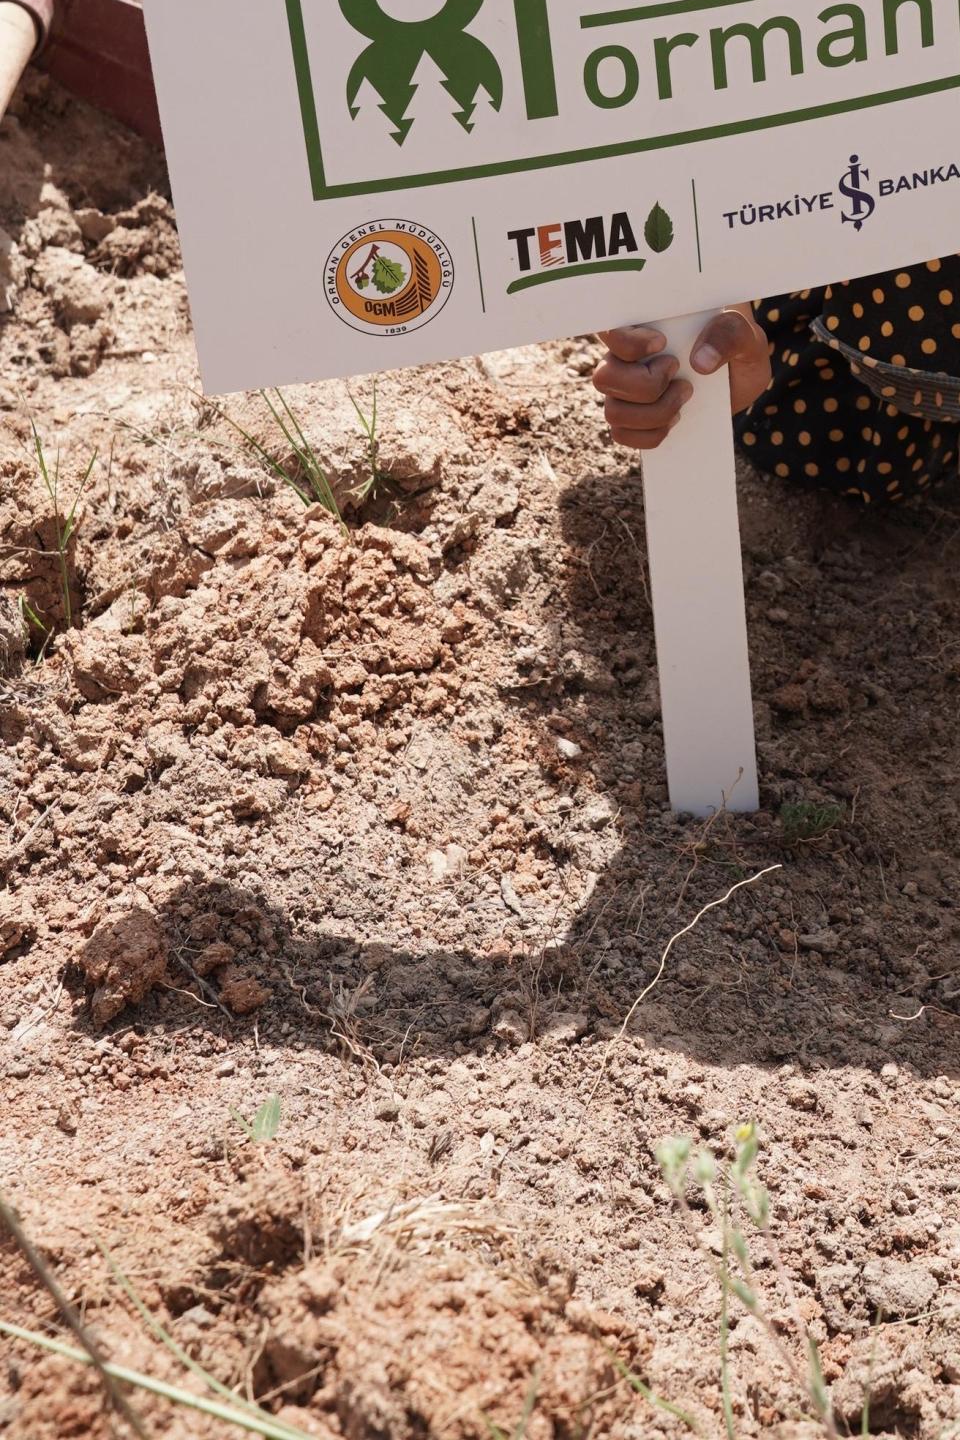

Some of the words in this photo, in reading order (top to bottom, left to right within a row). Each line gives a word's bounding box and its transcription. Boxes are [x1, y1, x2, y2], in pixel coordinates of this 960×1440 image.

[723, 192, 834, 229] TÜRKİYE
[507, 211, 639, 271] TEMA
[328, 255, 340, 305] ORMAN
[342, 223, 385, 249] GENEL
[396, 223, 451, 288] MÜDÜRLÜĞÜ
[364, 300, 396, 317] OGM
[385, 326, 407, 334] 1839
